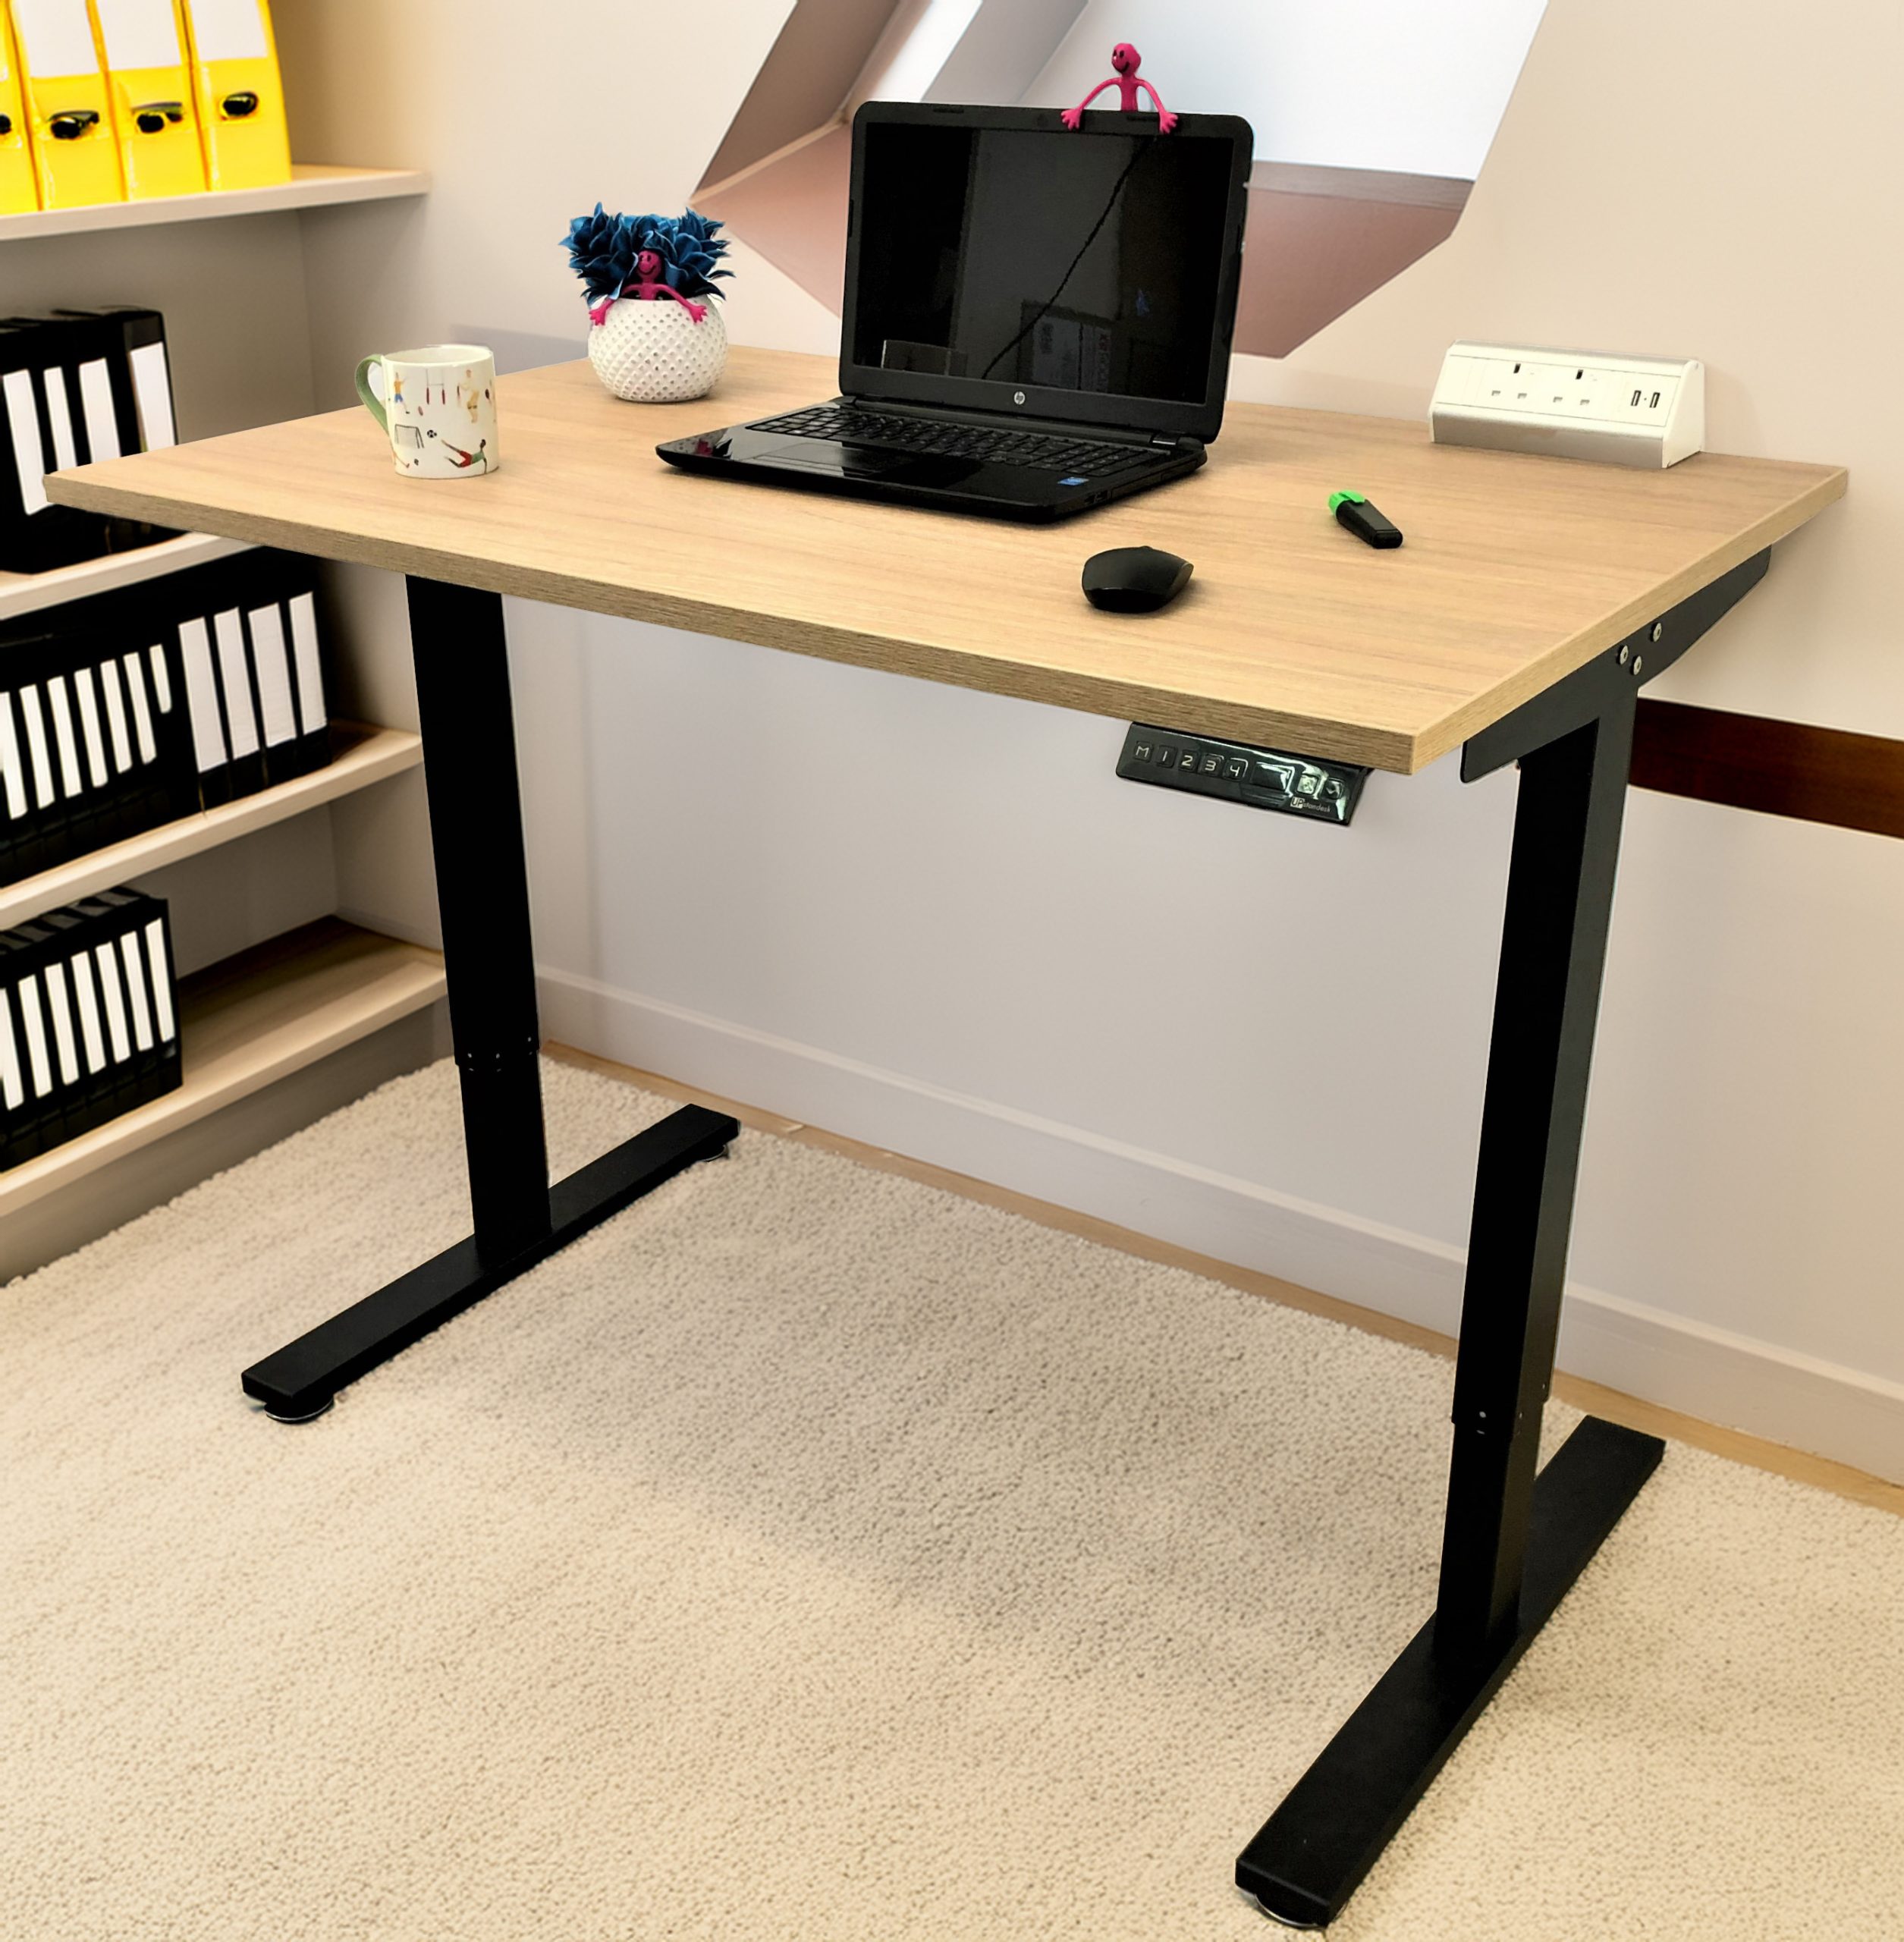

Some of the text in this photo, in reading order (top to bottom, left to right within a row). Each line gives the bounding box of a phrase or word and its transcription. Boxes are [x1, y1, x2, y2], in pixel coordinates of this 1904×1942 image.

[1136, 746, 1240, 777] M 1 2 3 4
